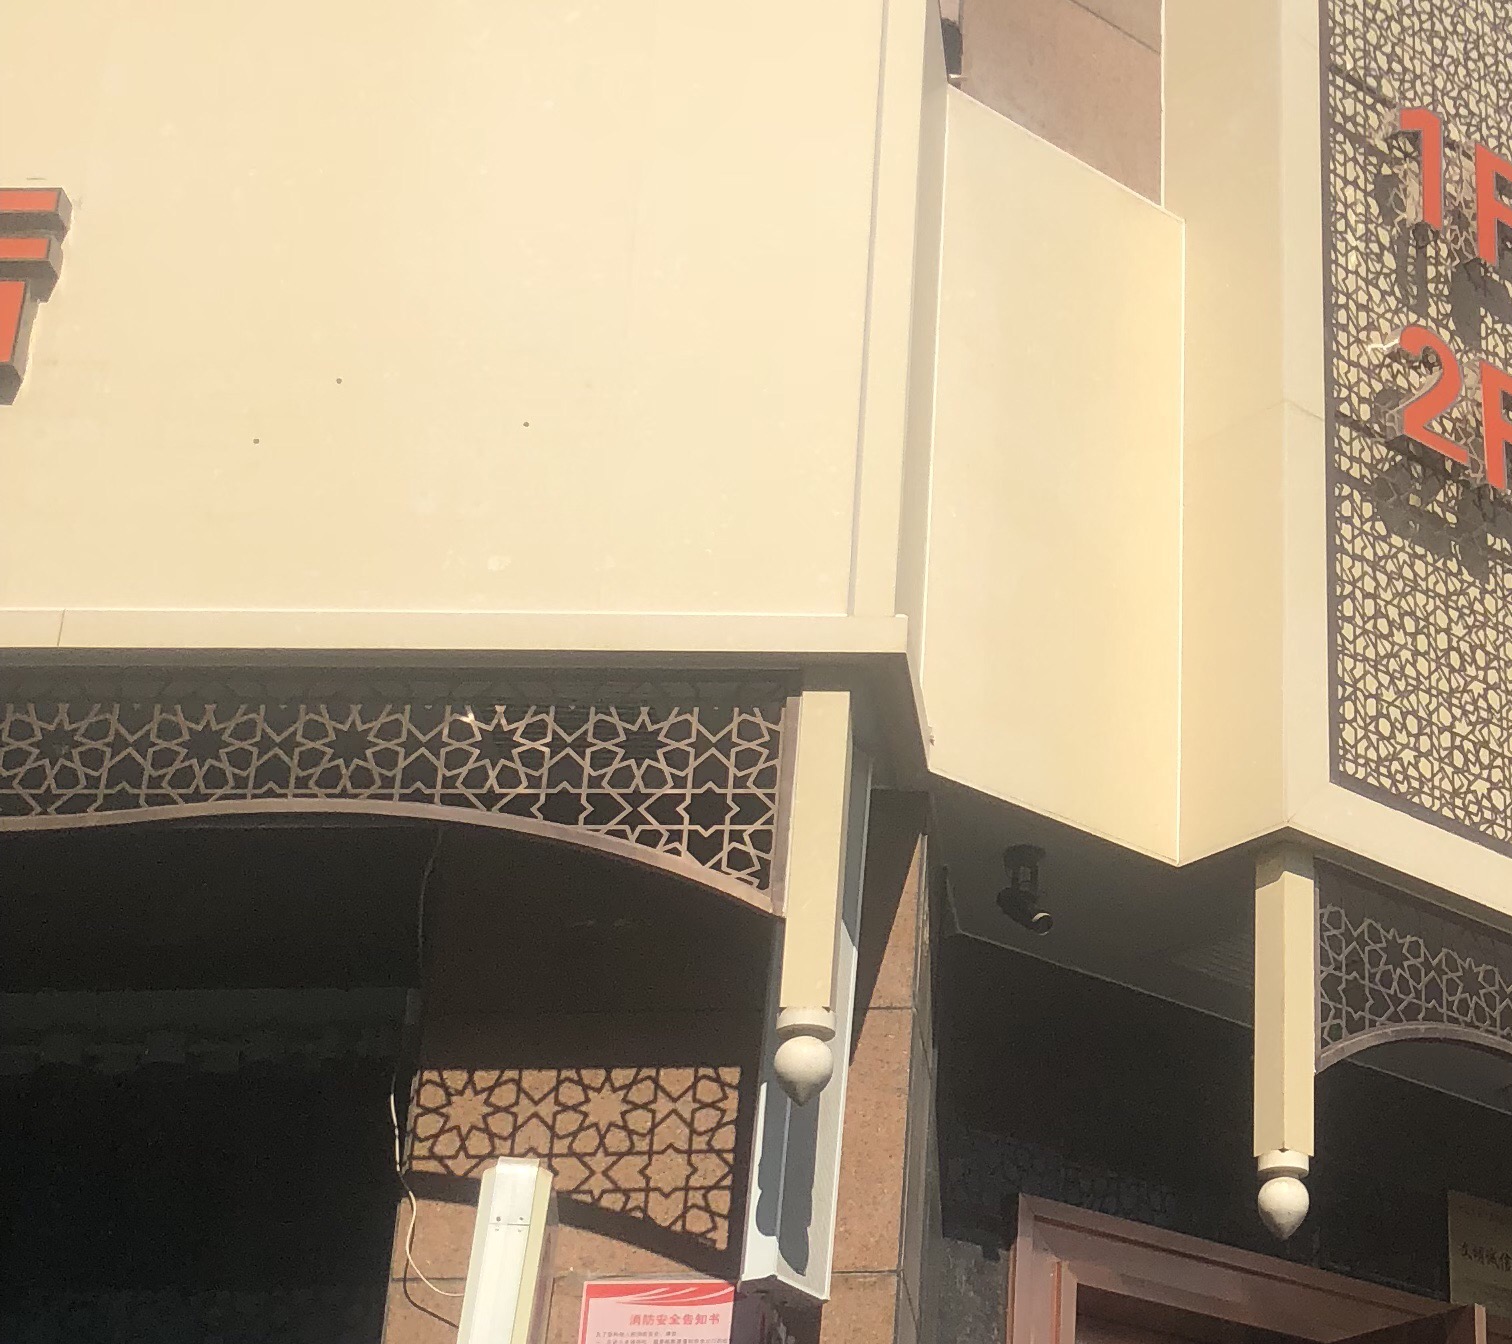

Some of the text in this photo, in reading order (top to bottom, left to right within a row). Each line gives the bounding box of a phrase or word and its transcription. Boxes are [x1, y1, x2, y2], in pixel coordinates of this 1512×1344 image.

[629, 1313, 720, 1326] 消防安全告知书
